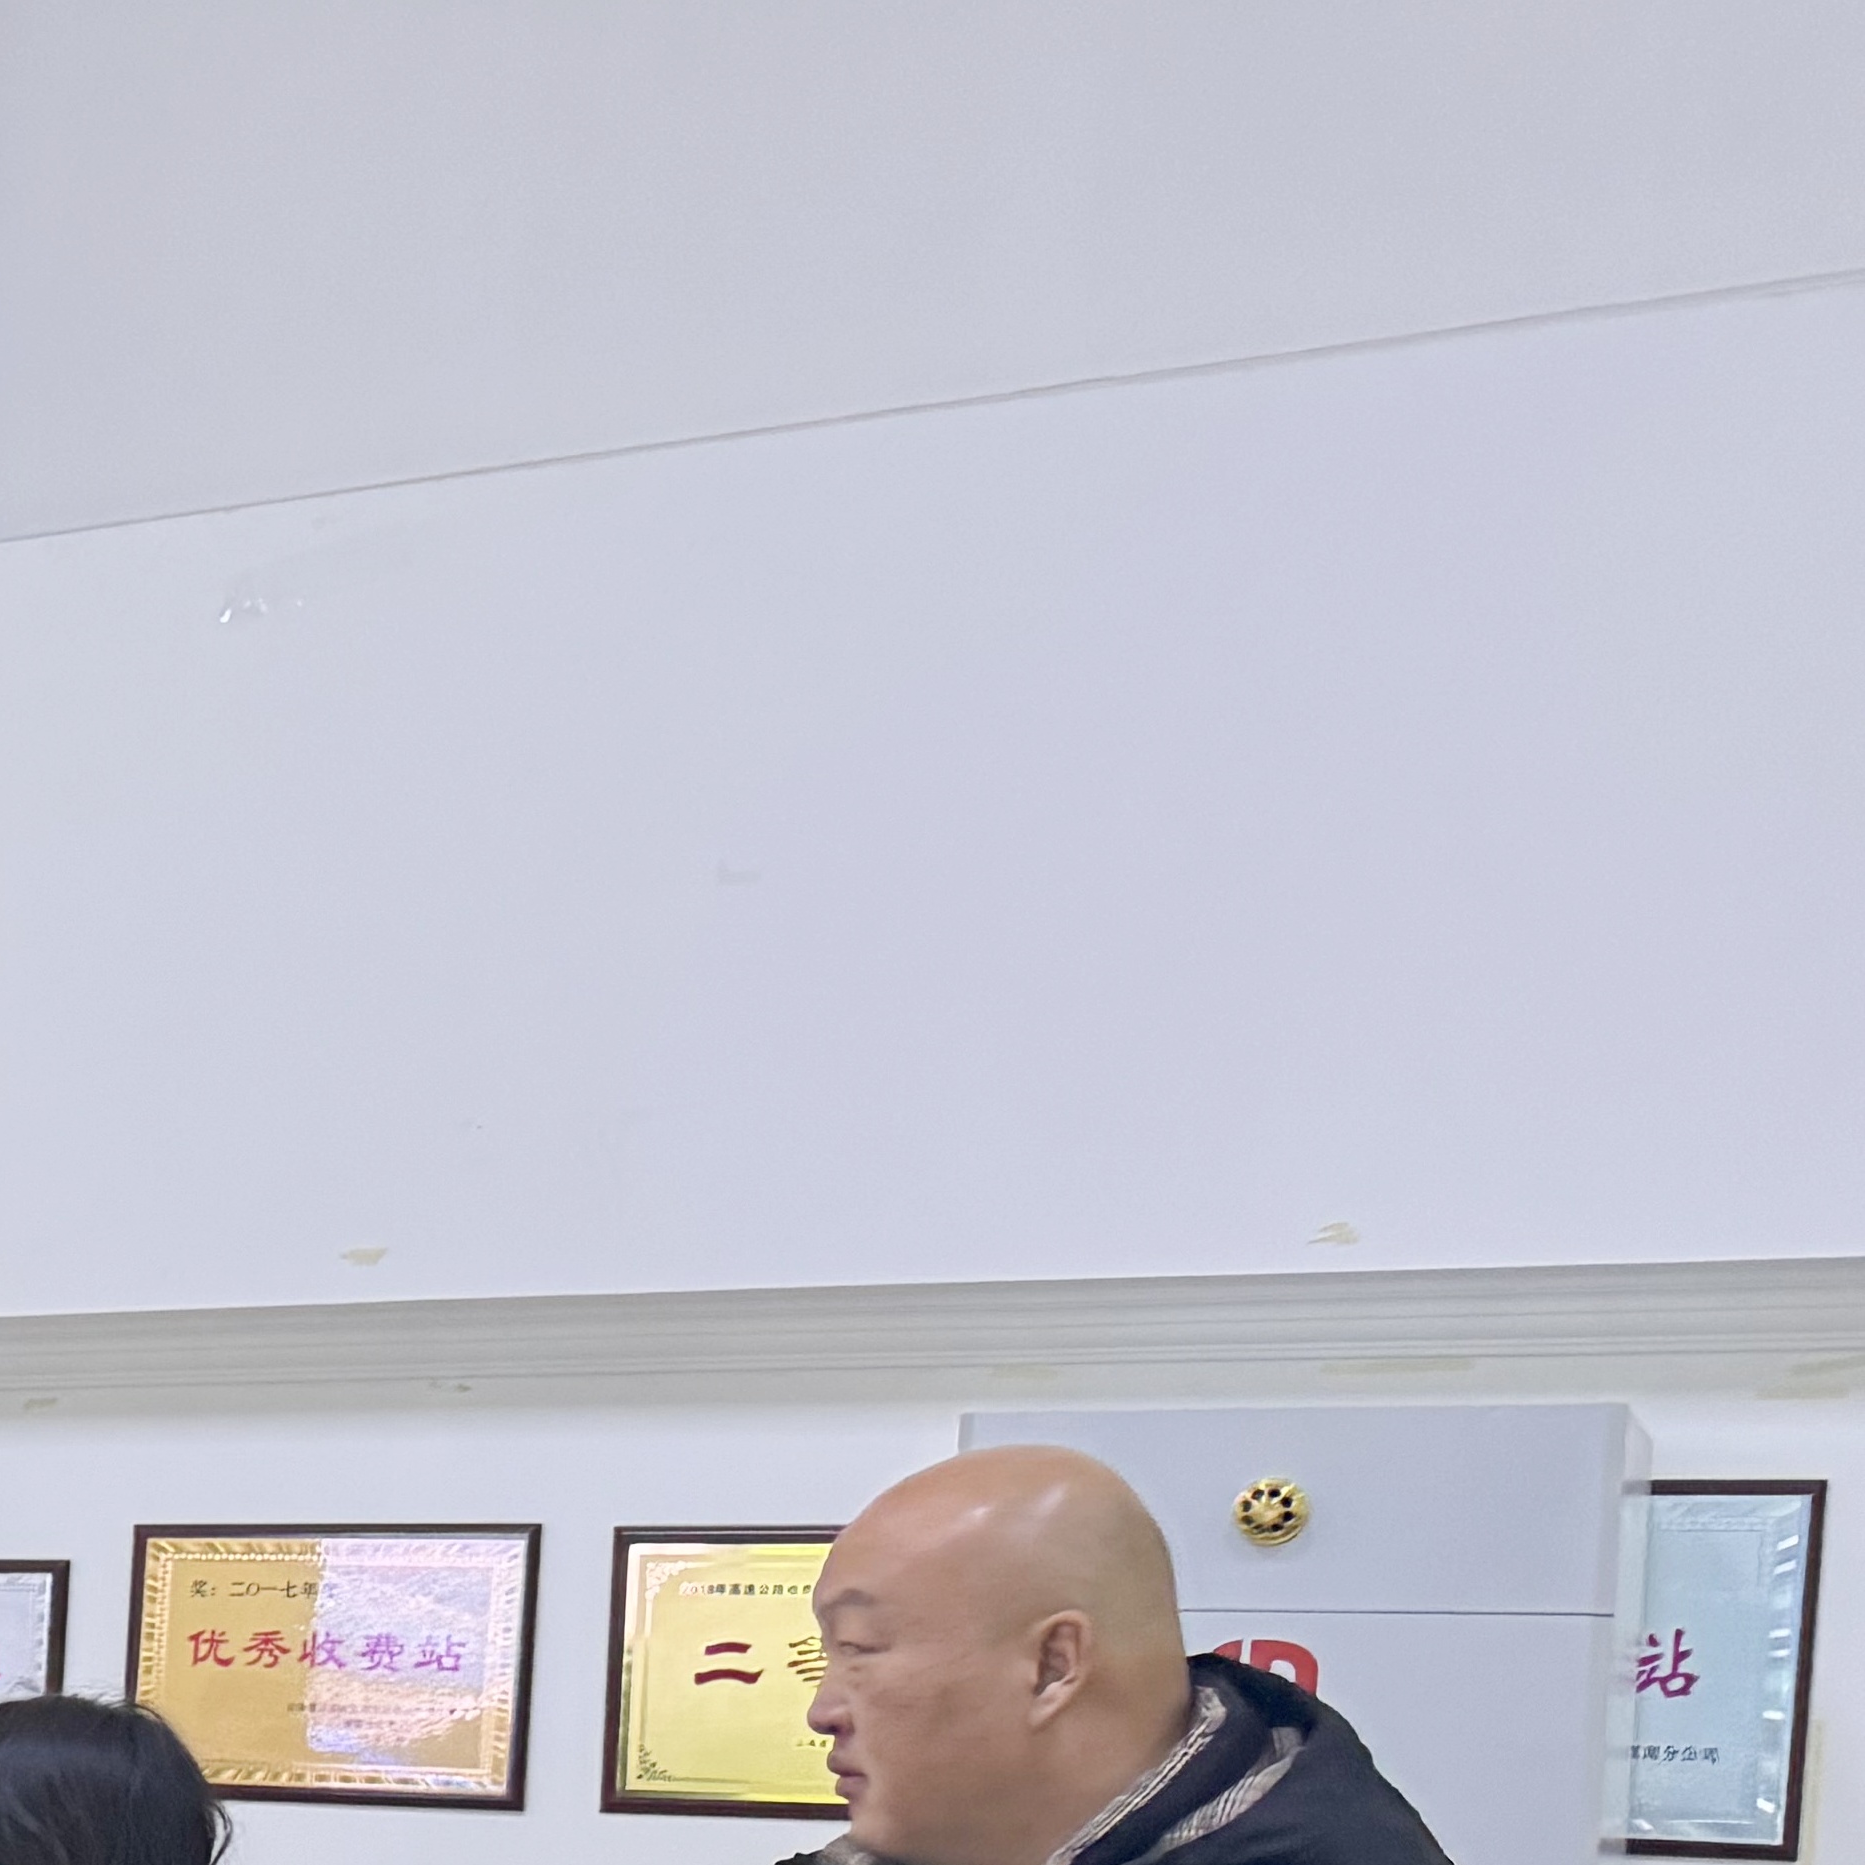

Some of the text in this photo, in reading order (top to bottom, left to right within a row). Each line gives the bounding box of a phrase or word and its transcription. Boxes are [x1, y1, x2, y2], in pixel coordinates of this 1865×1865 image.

[187, 1629, 467, 1673] 优秀收费站
[1635, 1627, 1701, 1699] 站
